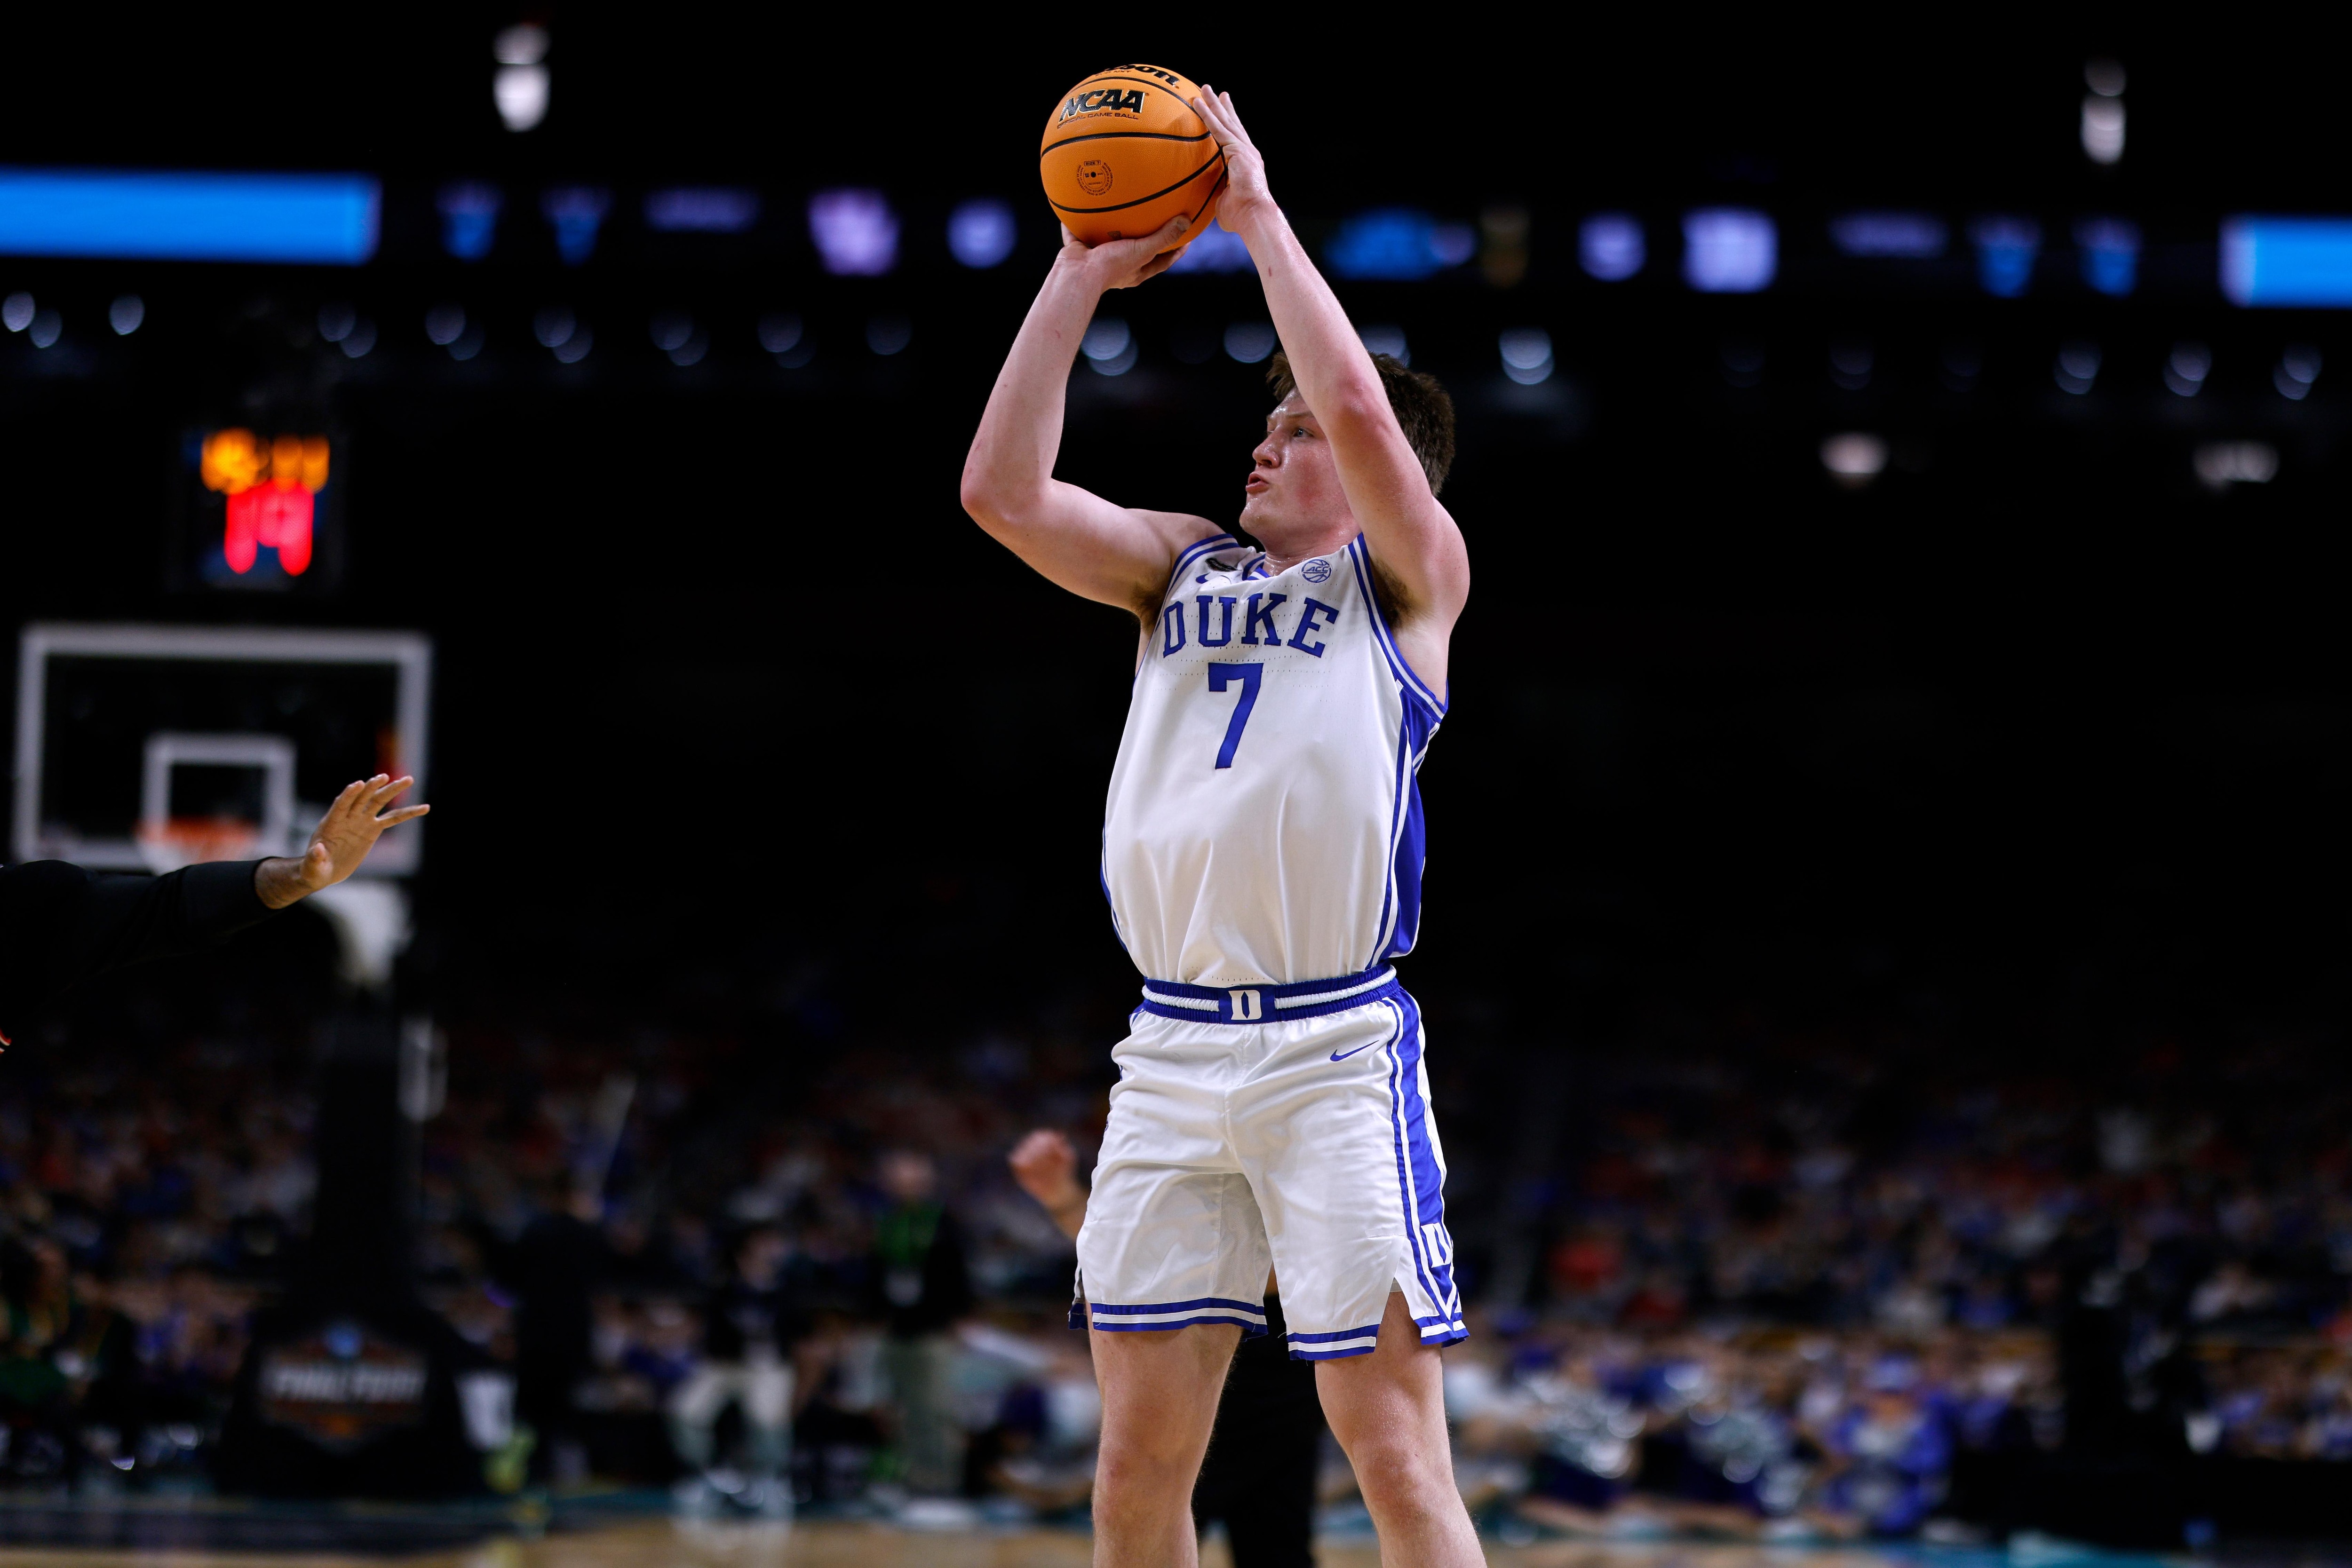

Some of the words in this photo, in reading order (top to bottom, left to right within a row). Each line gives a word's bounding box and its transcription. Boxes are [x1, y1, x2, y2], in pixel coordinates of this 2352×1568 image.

[1057, 116, 1085, 129] OFFICIAL
[1058, 89, 1145, 123] NCAA
[1163, 593, 1339, 658] DUKE
[1208, 662, 1264, 769] 7
[1228, 990, 1263, 1021] D
